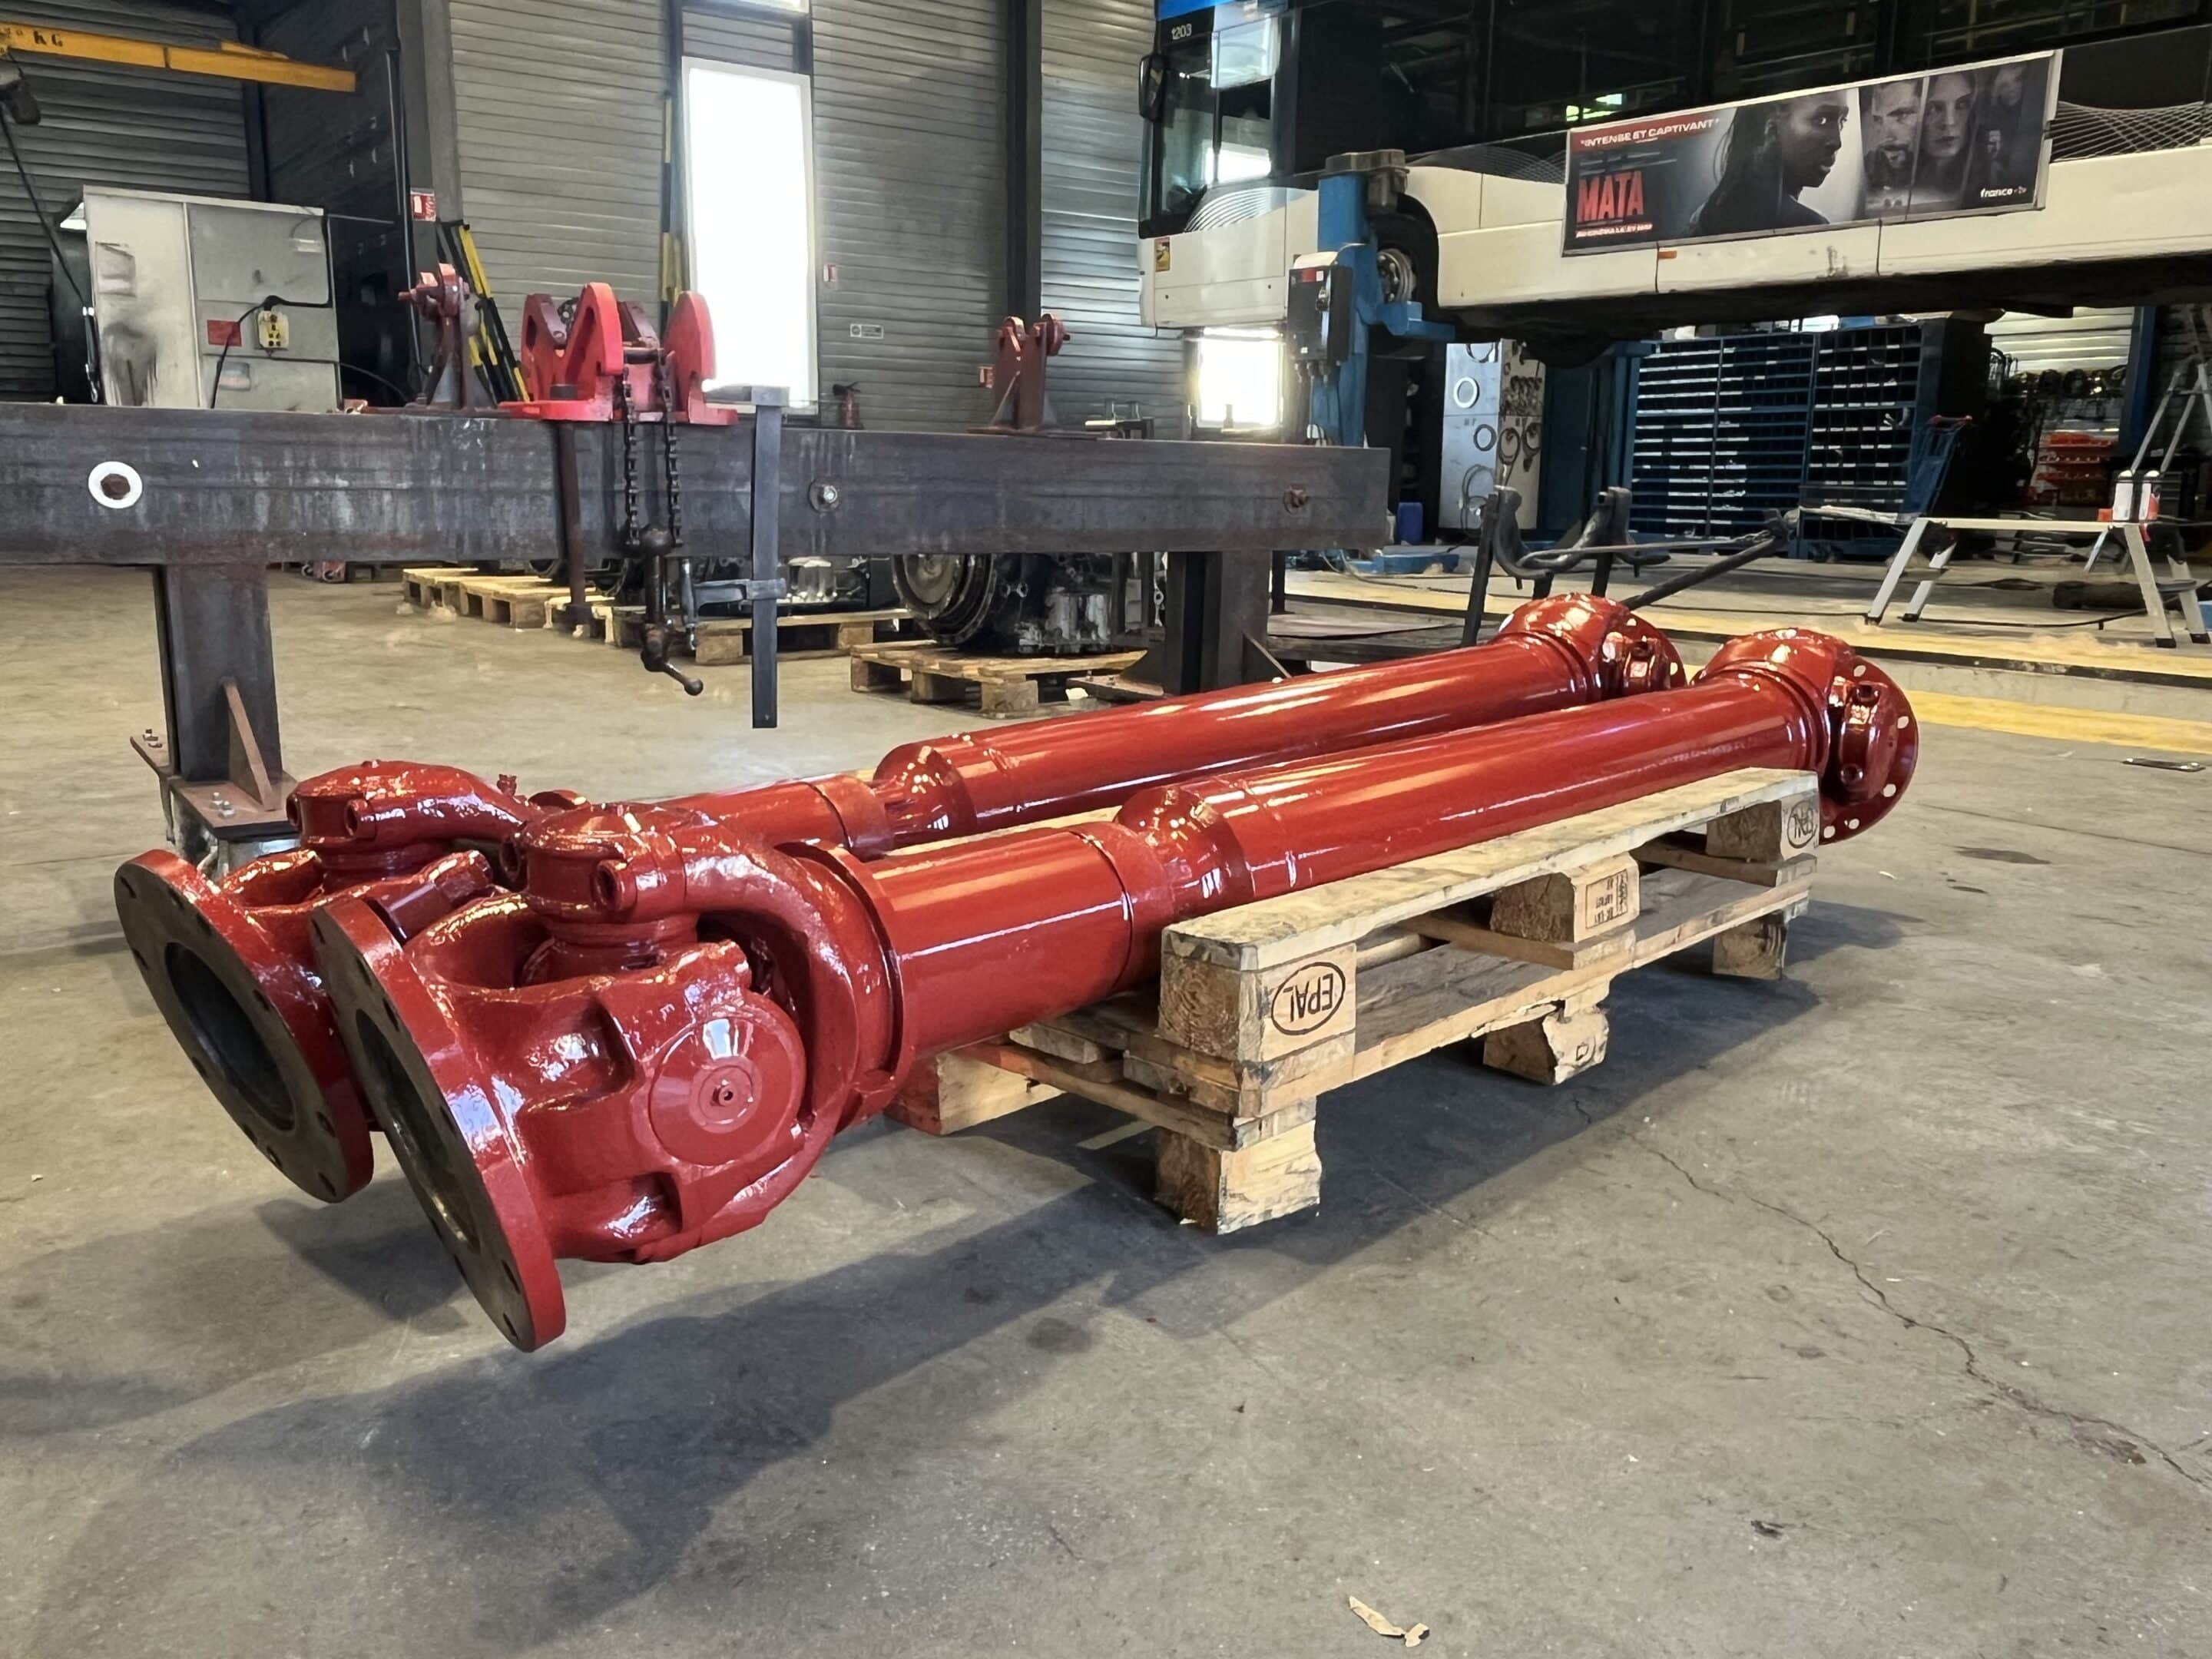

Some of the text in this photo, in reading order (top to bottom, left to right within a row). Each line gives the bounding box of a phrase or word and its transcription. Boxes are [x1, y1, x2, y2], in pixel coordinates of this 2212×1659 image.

[1633, 129, 1647, 140] ET
[1577, 171, 1644, 223] MATA
[1283, 973, 1333, 1022] EPAL
